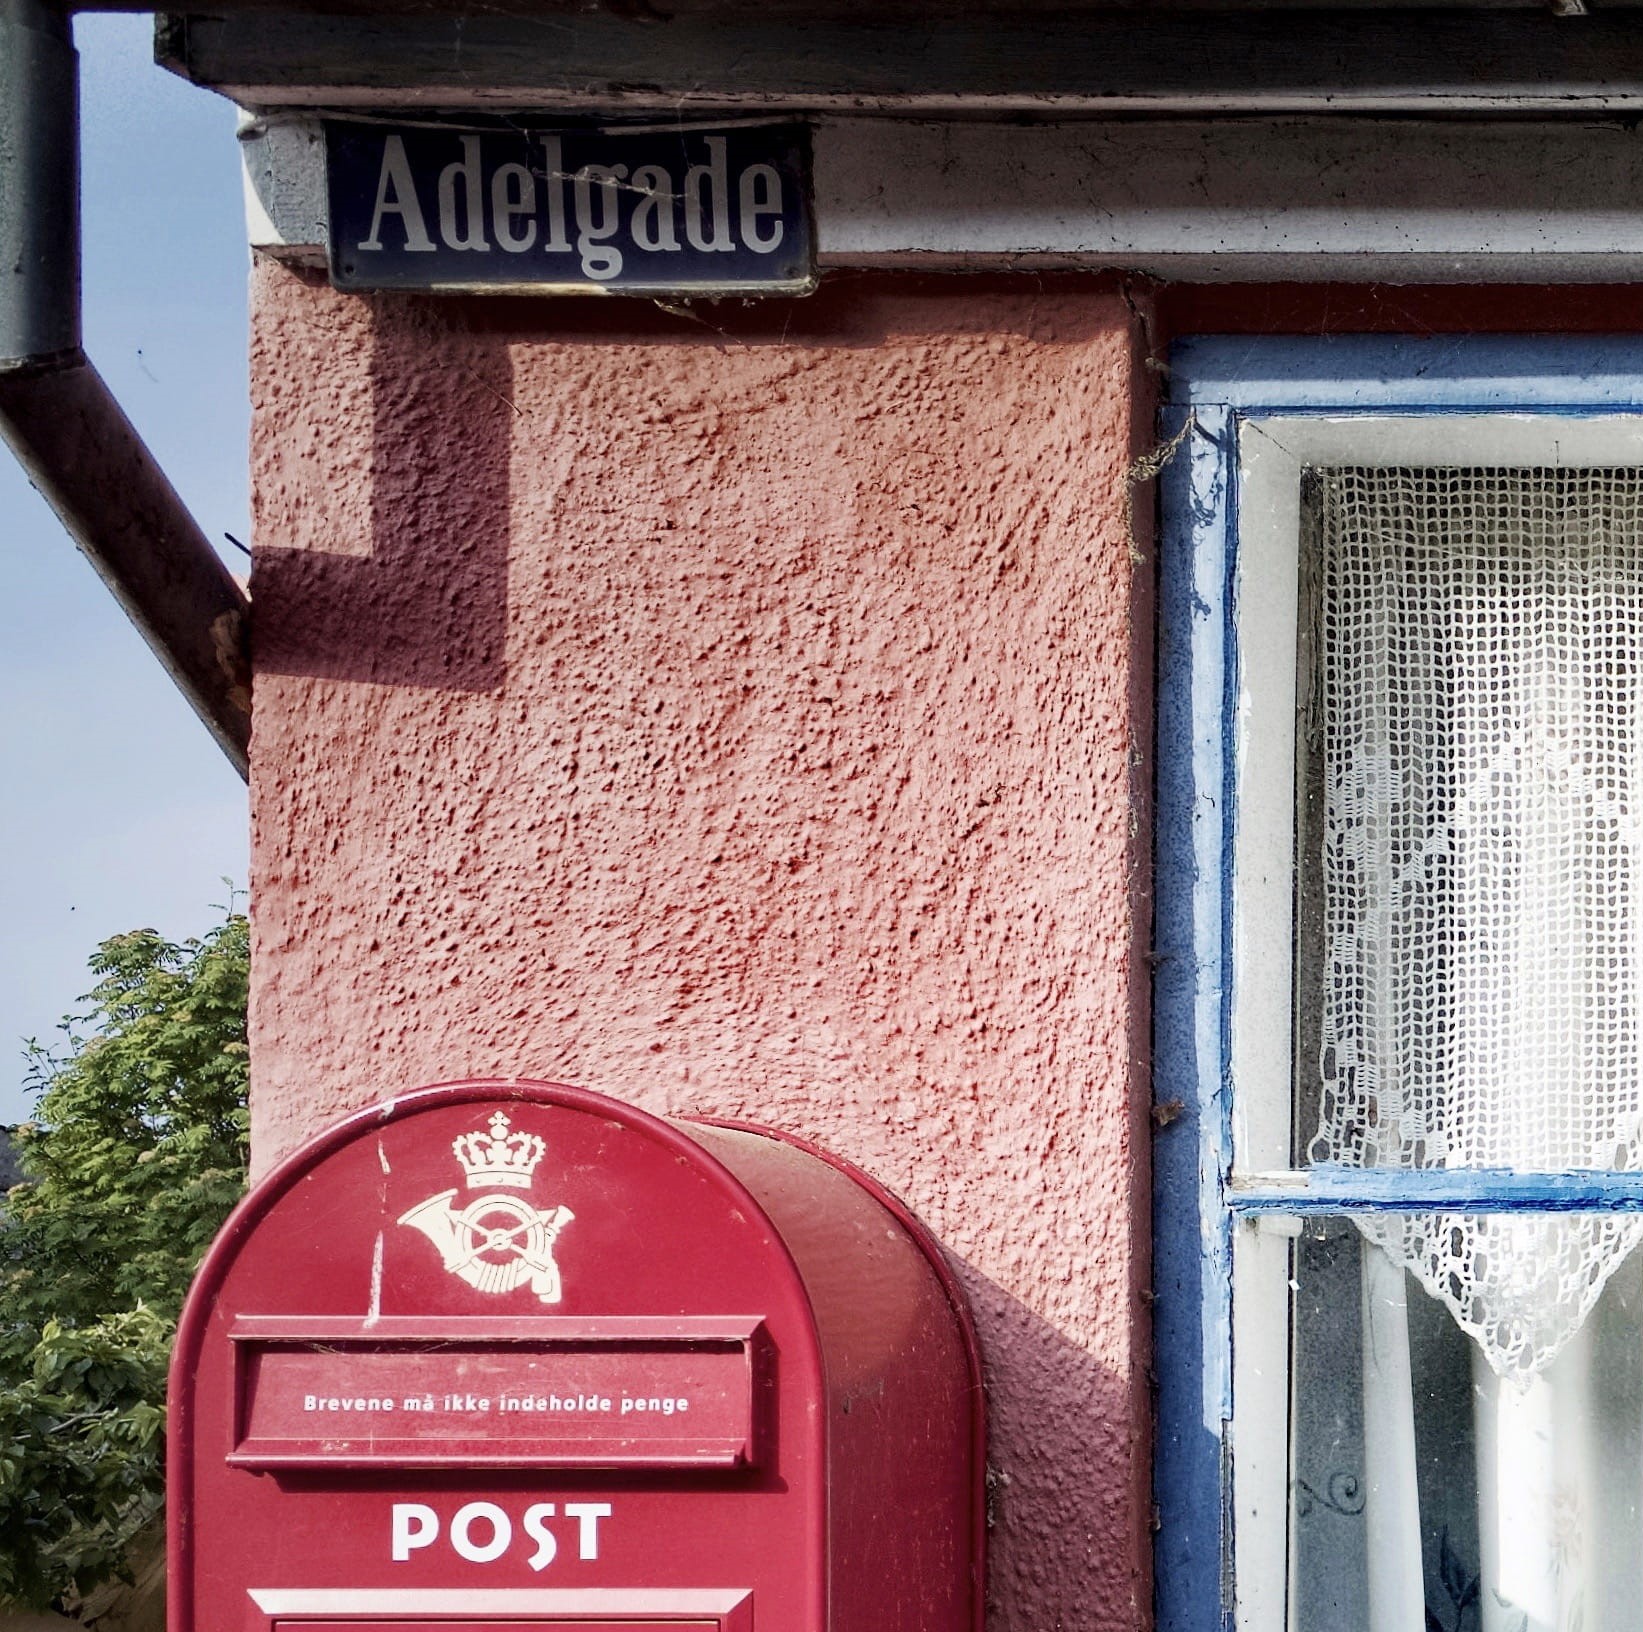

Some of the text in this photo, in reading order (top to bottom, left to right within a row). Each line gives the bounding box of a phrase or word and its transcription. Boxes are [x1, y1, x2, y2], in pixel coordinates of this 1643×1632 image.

[358, 135, 784, 279] Adelgade
[304, 1394, 689, 1415] Brevene må ikke indeholde penge
[391, 1501, 612, 1572] POST
